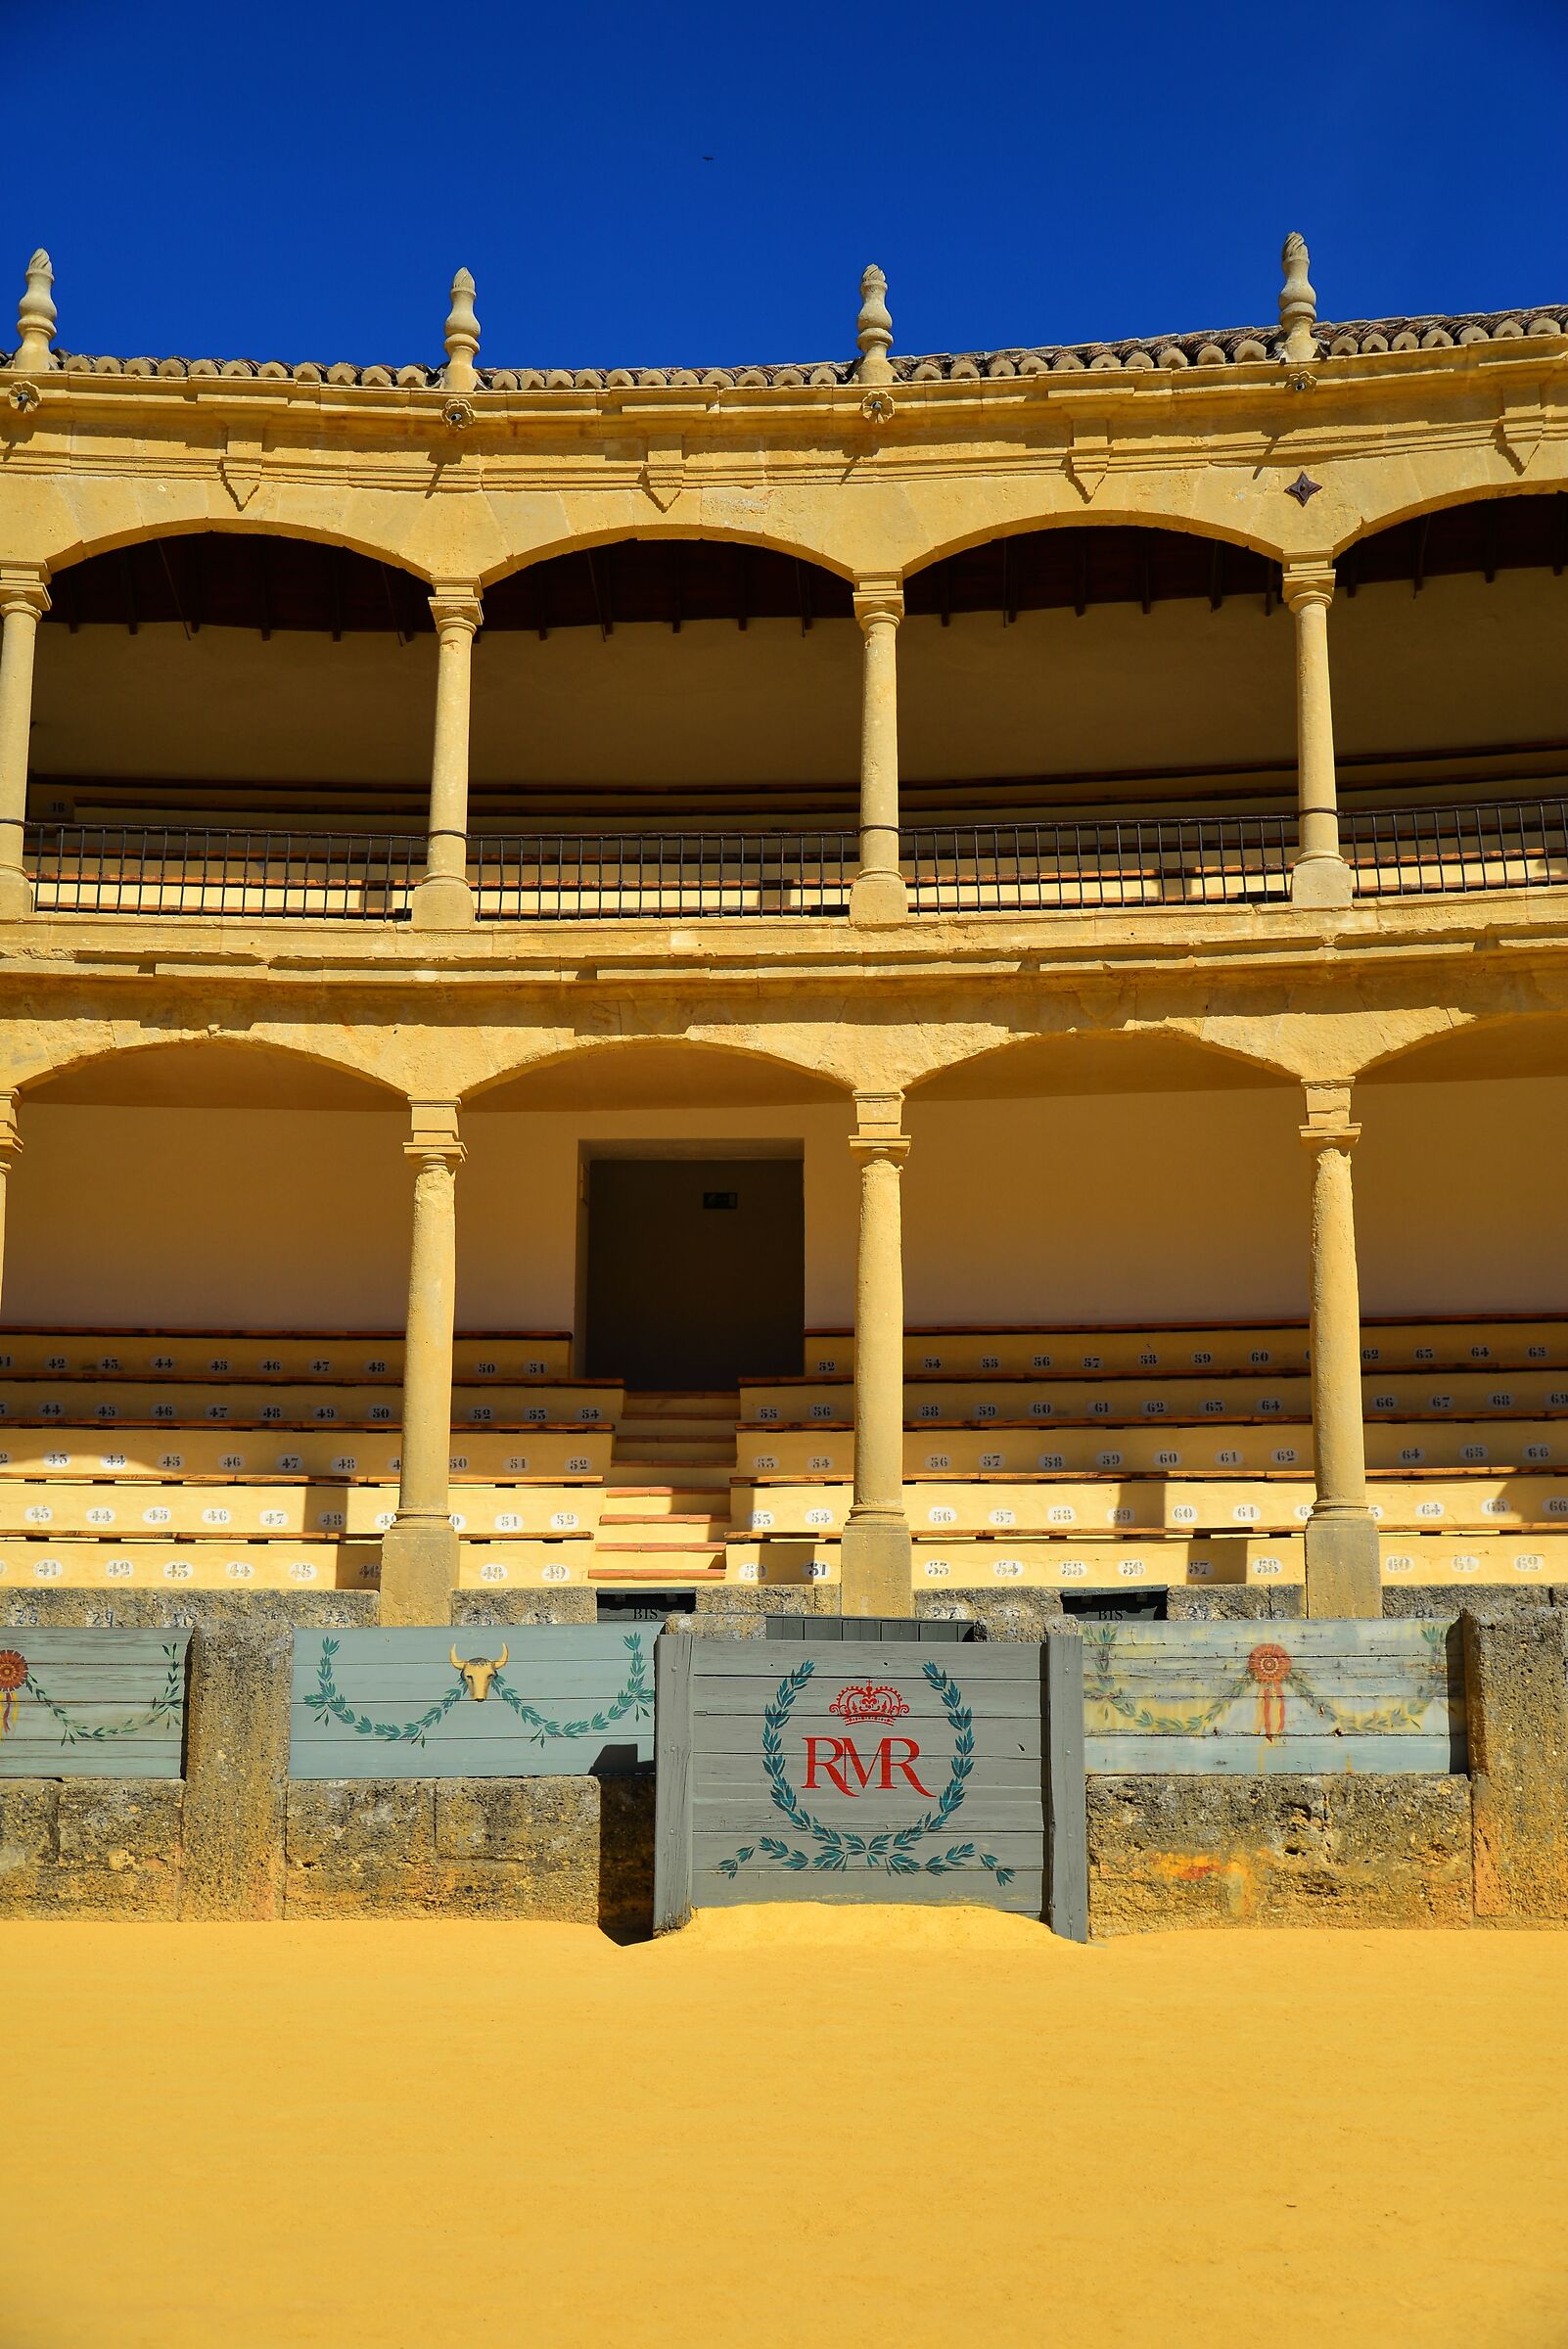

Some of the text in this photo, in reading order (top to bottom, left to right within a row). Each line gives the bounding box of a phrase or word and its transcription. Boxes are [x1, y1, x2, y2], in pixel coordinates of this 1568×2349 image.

[1250, 1351, 1269, 1362] 60
[1361, 1349, 1380, 1360] 62
[1414, 1348, 1434, 1359] 63
[1470, 1346, 1490, 1358] 64
[1527, 1347, 1547, 1358] 65
[47, 1358, 67, 1369] 42
[101, 1358, 119, 1370] 43
[154, 1359, 174, 1369] 44
[924, 1358, 942, 1369] 54
[982, 1359, 999, 1369] 55
[1033, 1356, 1051, 1367] 56
[1083, 1358, 1101, 1369] 57
[1140, 1354, 1158, 1364] 58
[1193, 1353, 1212, 1364] 59
[210, 1359, 229, 1371] 45
[262, 1359, 281, 1371] 46
[312, 1360, 330, 1372] 47
[367, 1361, 386, 1373] 48
[478, 1362, 495, 1374] 50
[529, 1362, 545, 1374] 51
[817, 1361, 836, 1372] 52
[1261, 1400, 1281, 1411] 64
[1374, 1397, 1394, 1408] 66
[1431, 1395, 1452, 1407] 67
[1492, 1394, 1511, 1406] 68
[41, 1404, 61, 1416] 44
[97, 1405, 116, 1417] 45
[155, 1405, 173, 1417] 46
[208, 1406, 228, 1418] 47
[262, 1406, 282, 1419] 48
[371, 1407, 390, 1418] 50
[812, 1405, 832, 1417] 56
[921, 1405, 940, 1417] 58
[978, 1405, 996, 1416] 59
[1032, 1403, 1051, 1415] 60
[1093, 1402, 1110, 1413] 61
[1146, 1402, 1165, 1413] 62
[1205, 1401, 1224, 1412] 63
[316, 1407, 335, 1419] 49
[473, 1408, 491, 1420] 52
[528, 1409, 546, 1421] 53
[580, 1408, 600, 1419] 54
[760, 1408, 778, 1419] 55
[49, 1452, 69, 1465] 43
[1158, 1452, 1177, 1464] 60
[1220, 1451, 1237, 1463] 61
[1275, 1450, 1295, 1462] 62
[1402, 1449, 1421, 1460] 64
[1464, 1447, 1485, 1458] 65
[1527, 1447, 1549, 1458] 66
[106, 1453, 126, 1466] 44
[161, 1455, 181, 1468] 45
[223, 1455, 241, 1468] 46
[281, 1456, 300, 1469] 47
[337, 1457, 355, 1470] 48
[448, 1457, 468, 1469] 50
[509, 1457, 526, 1470] 51
[570, 1459, 588, 1471] 52
[757, 1456, 774, 1469] 53
[811, 1457, 831, 1469] 54
[930, 1456, 948, 1467] 56
[982, 1455, 1001, 1467] 57
[1043, 1455, 1063, 1468] 58
[1102, 1453, 1121, 1465] 59
[801, 1735, 937, 1797] RMR
